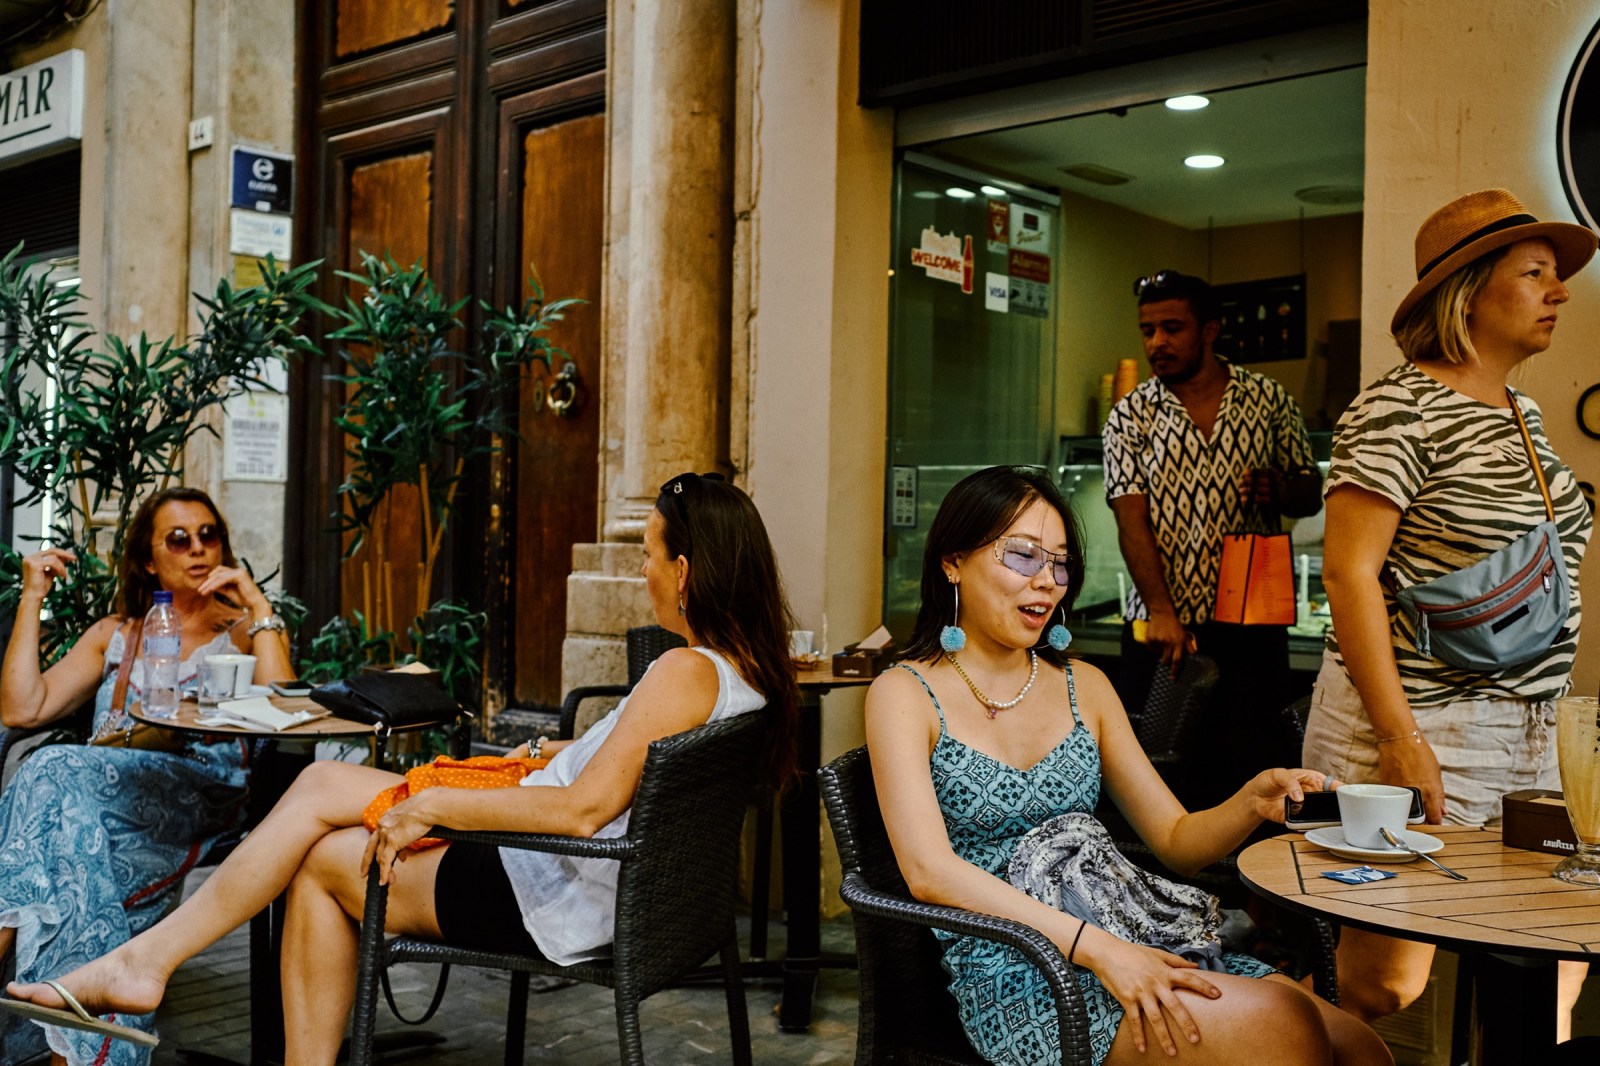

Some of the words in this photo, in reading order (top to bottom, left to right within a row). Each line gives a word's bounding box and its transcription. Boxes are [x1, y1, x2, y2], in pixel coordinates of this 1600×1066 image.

[912, 250, 961, 273] WELCOME
[989, 285, 1007, 298] VISA
[1543, 839, 1575, 851] LAVAZZA
